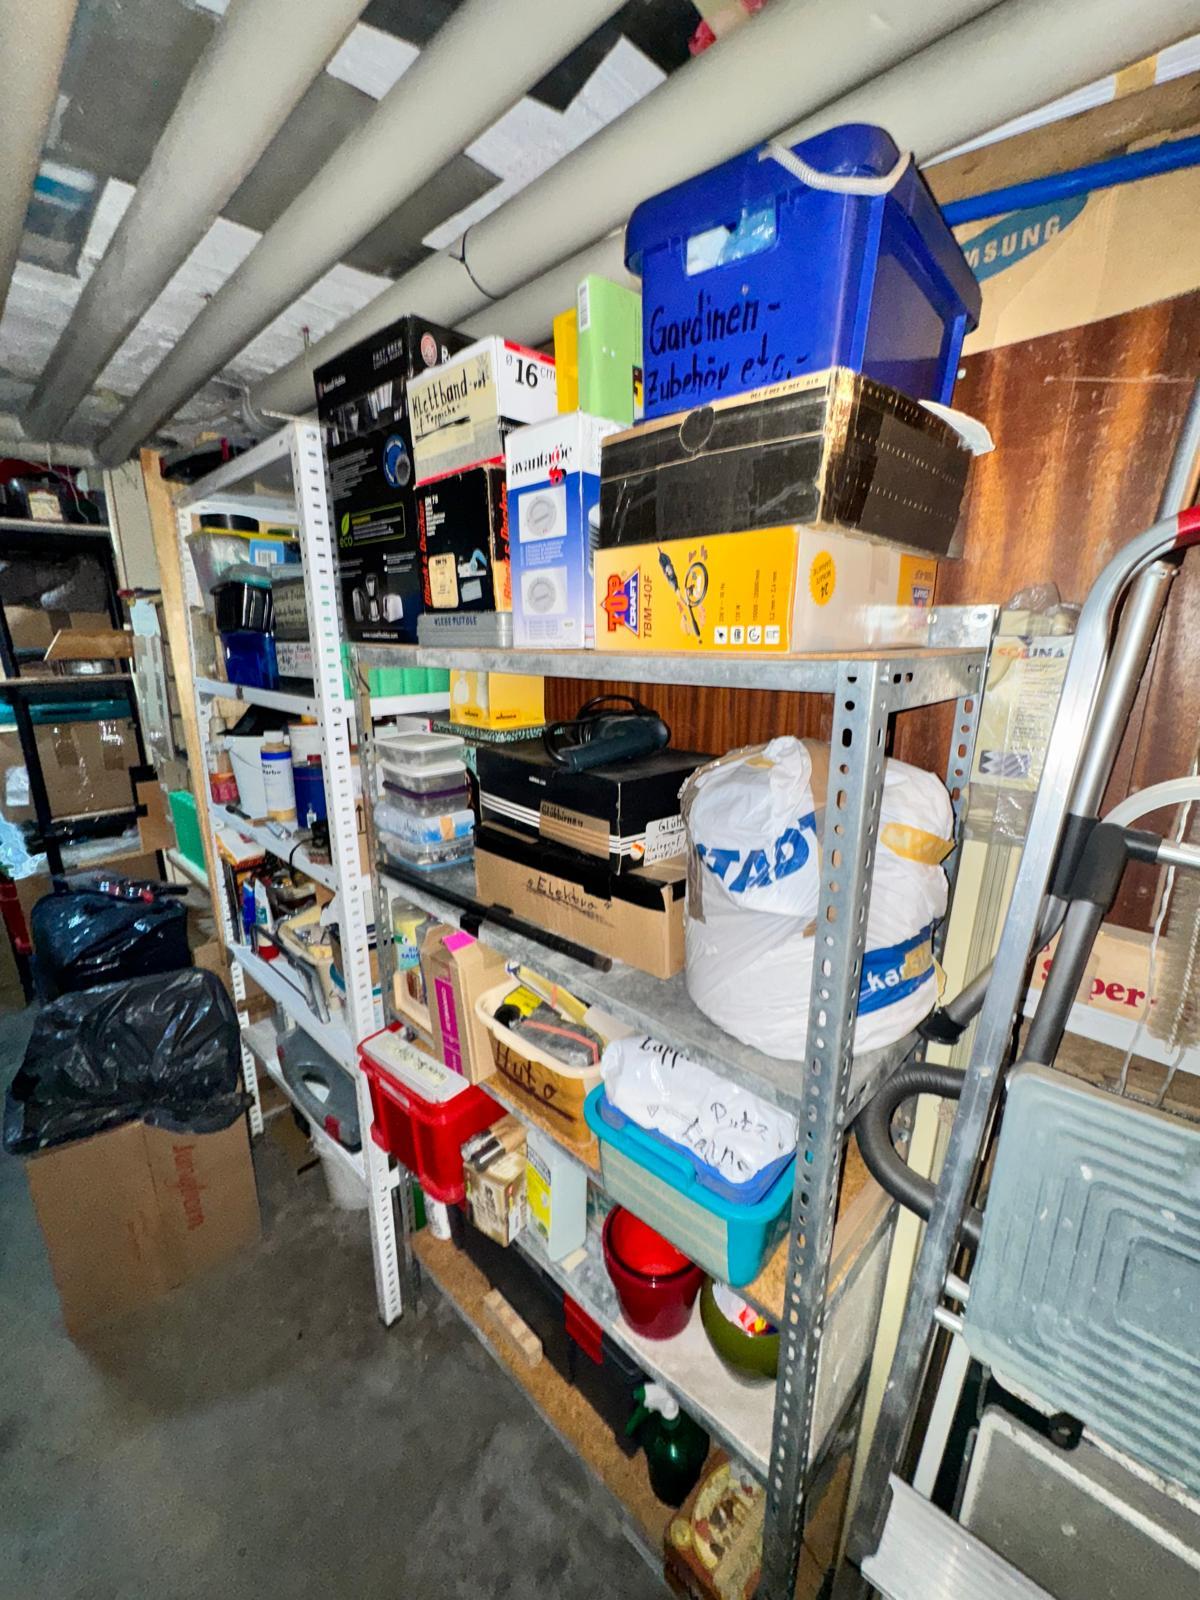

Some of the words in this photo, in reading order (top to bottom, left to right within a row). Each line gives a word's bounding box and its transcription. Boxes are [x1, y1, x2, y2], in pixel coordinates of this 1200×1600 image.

[963, 214, 1061, 269] MSUNG
[411, 368, 469, 420] Klettband
[514, 358, 539, 389] 16
[418, 500, 428, 553] Decker
[421, 565, 433, 608] Black
[606, 574, 630, 633] TOP
[629, 579, 639, 628] CRAFT
[643, 575, 653, 639] TBM-40F
